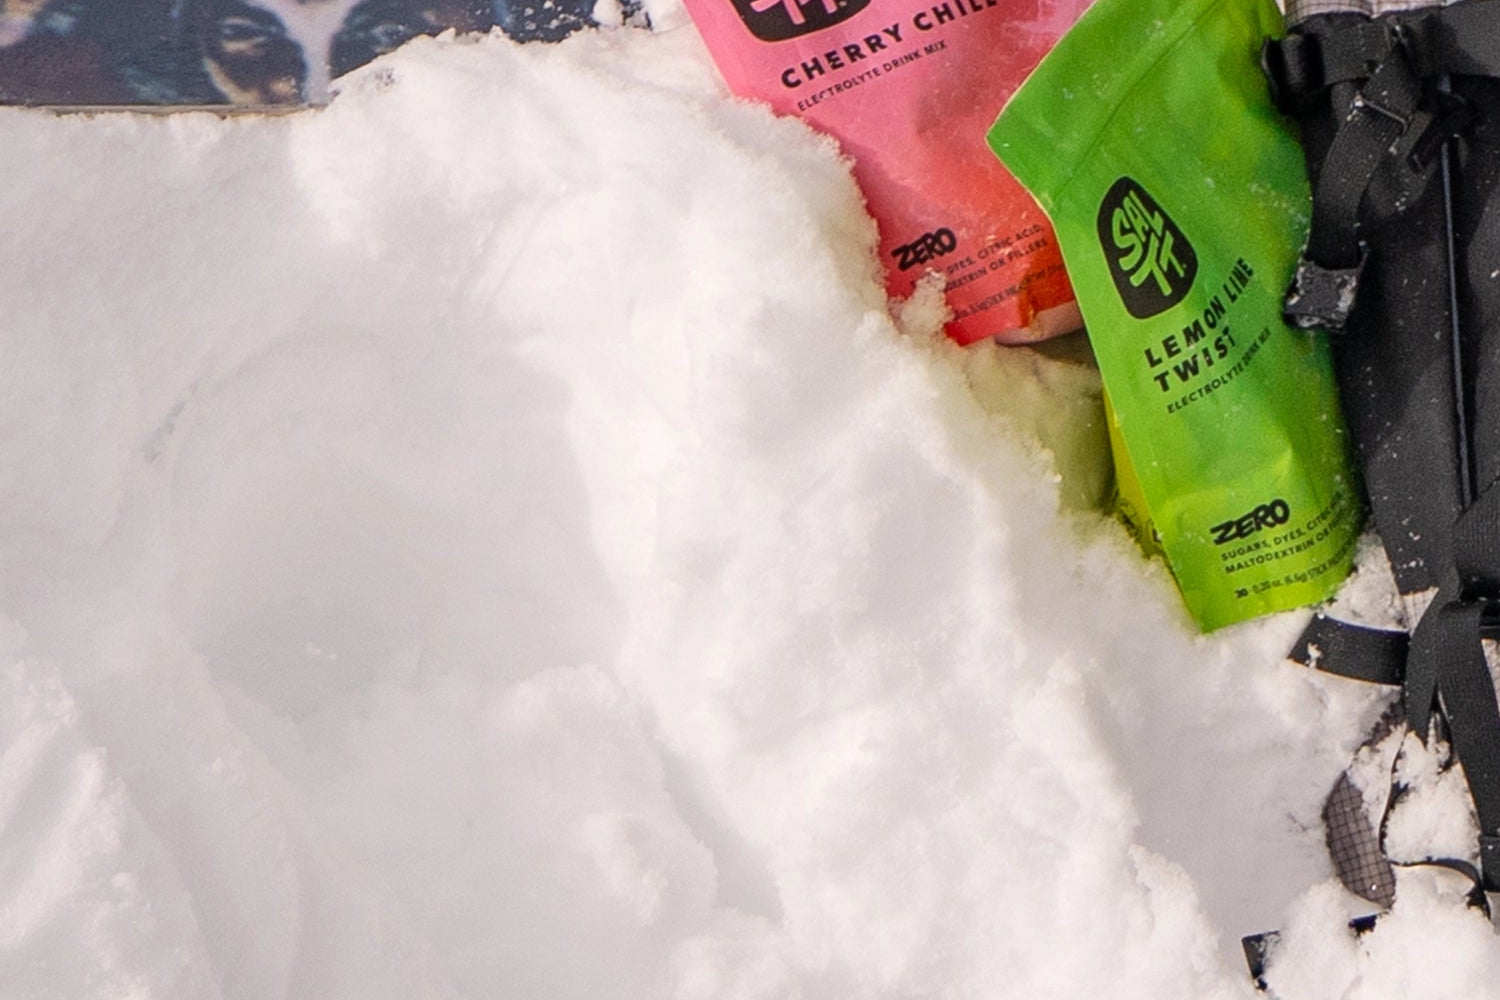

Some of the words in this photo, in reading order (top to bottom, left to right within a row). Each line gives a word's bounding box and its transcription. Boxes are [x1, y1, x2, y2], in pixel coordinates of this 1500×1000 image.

[781, 23, 904, 89] CHERRY
[797, 67, 882, 112] ELECTROLYTE
[883, 50, 922, 73] DRINK
[924, 39, 947, 57] MIX
[891, 228, 957, 272] ZERO
[978, 238, 1012, 260] CITRIC
[989, 257, 1006, 271] OR
[1008, 238, 1048, 263] FILLERS
[1112, 190, 1164, 272] SAL
[1129, 231, 1185, 297] TT
[1144, 295, 1226, 369] LEMON
[1154, 326, 1236, 393] TWIST
[1167, 361, 1244, 414] ELECTROLYTE
[1209, 499, 1290, 545] ZERO
[1222, 539, 1271, 562] SUGARS,
[1225, 538, 1315, 575] MALTODEXTRIN
